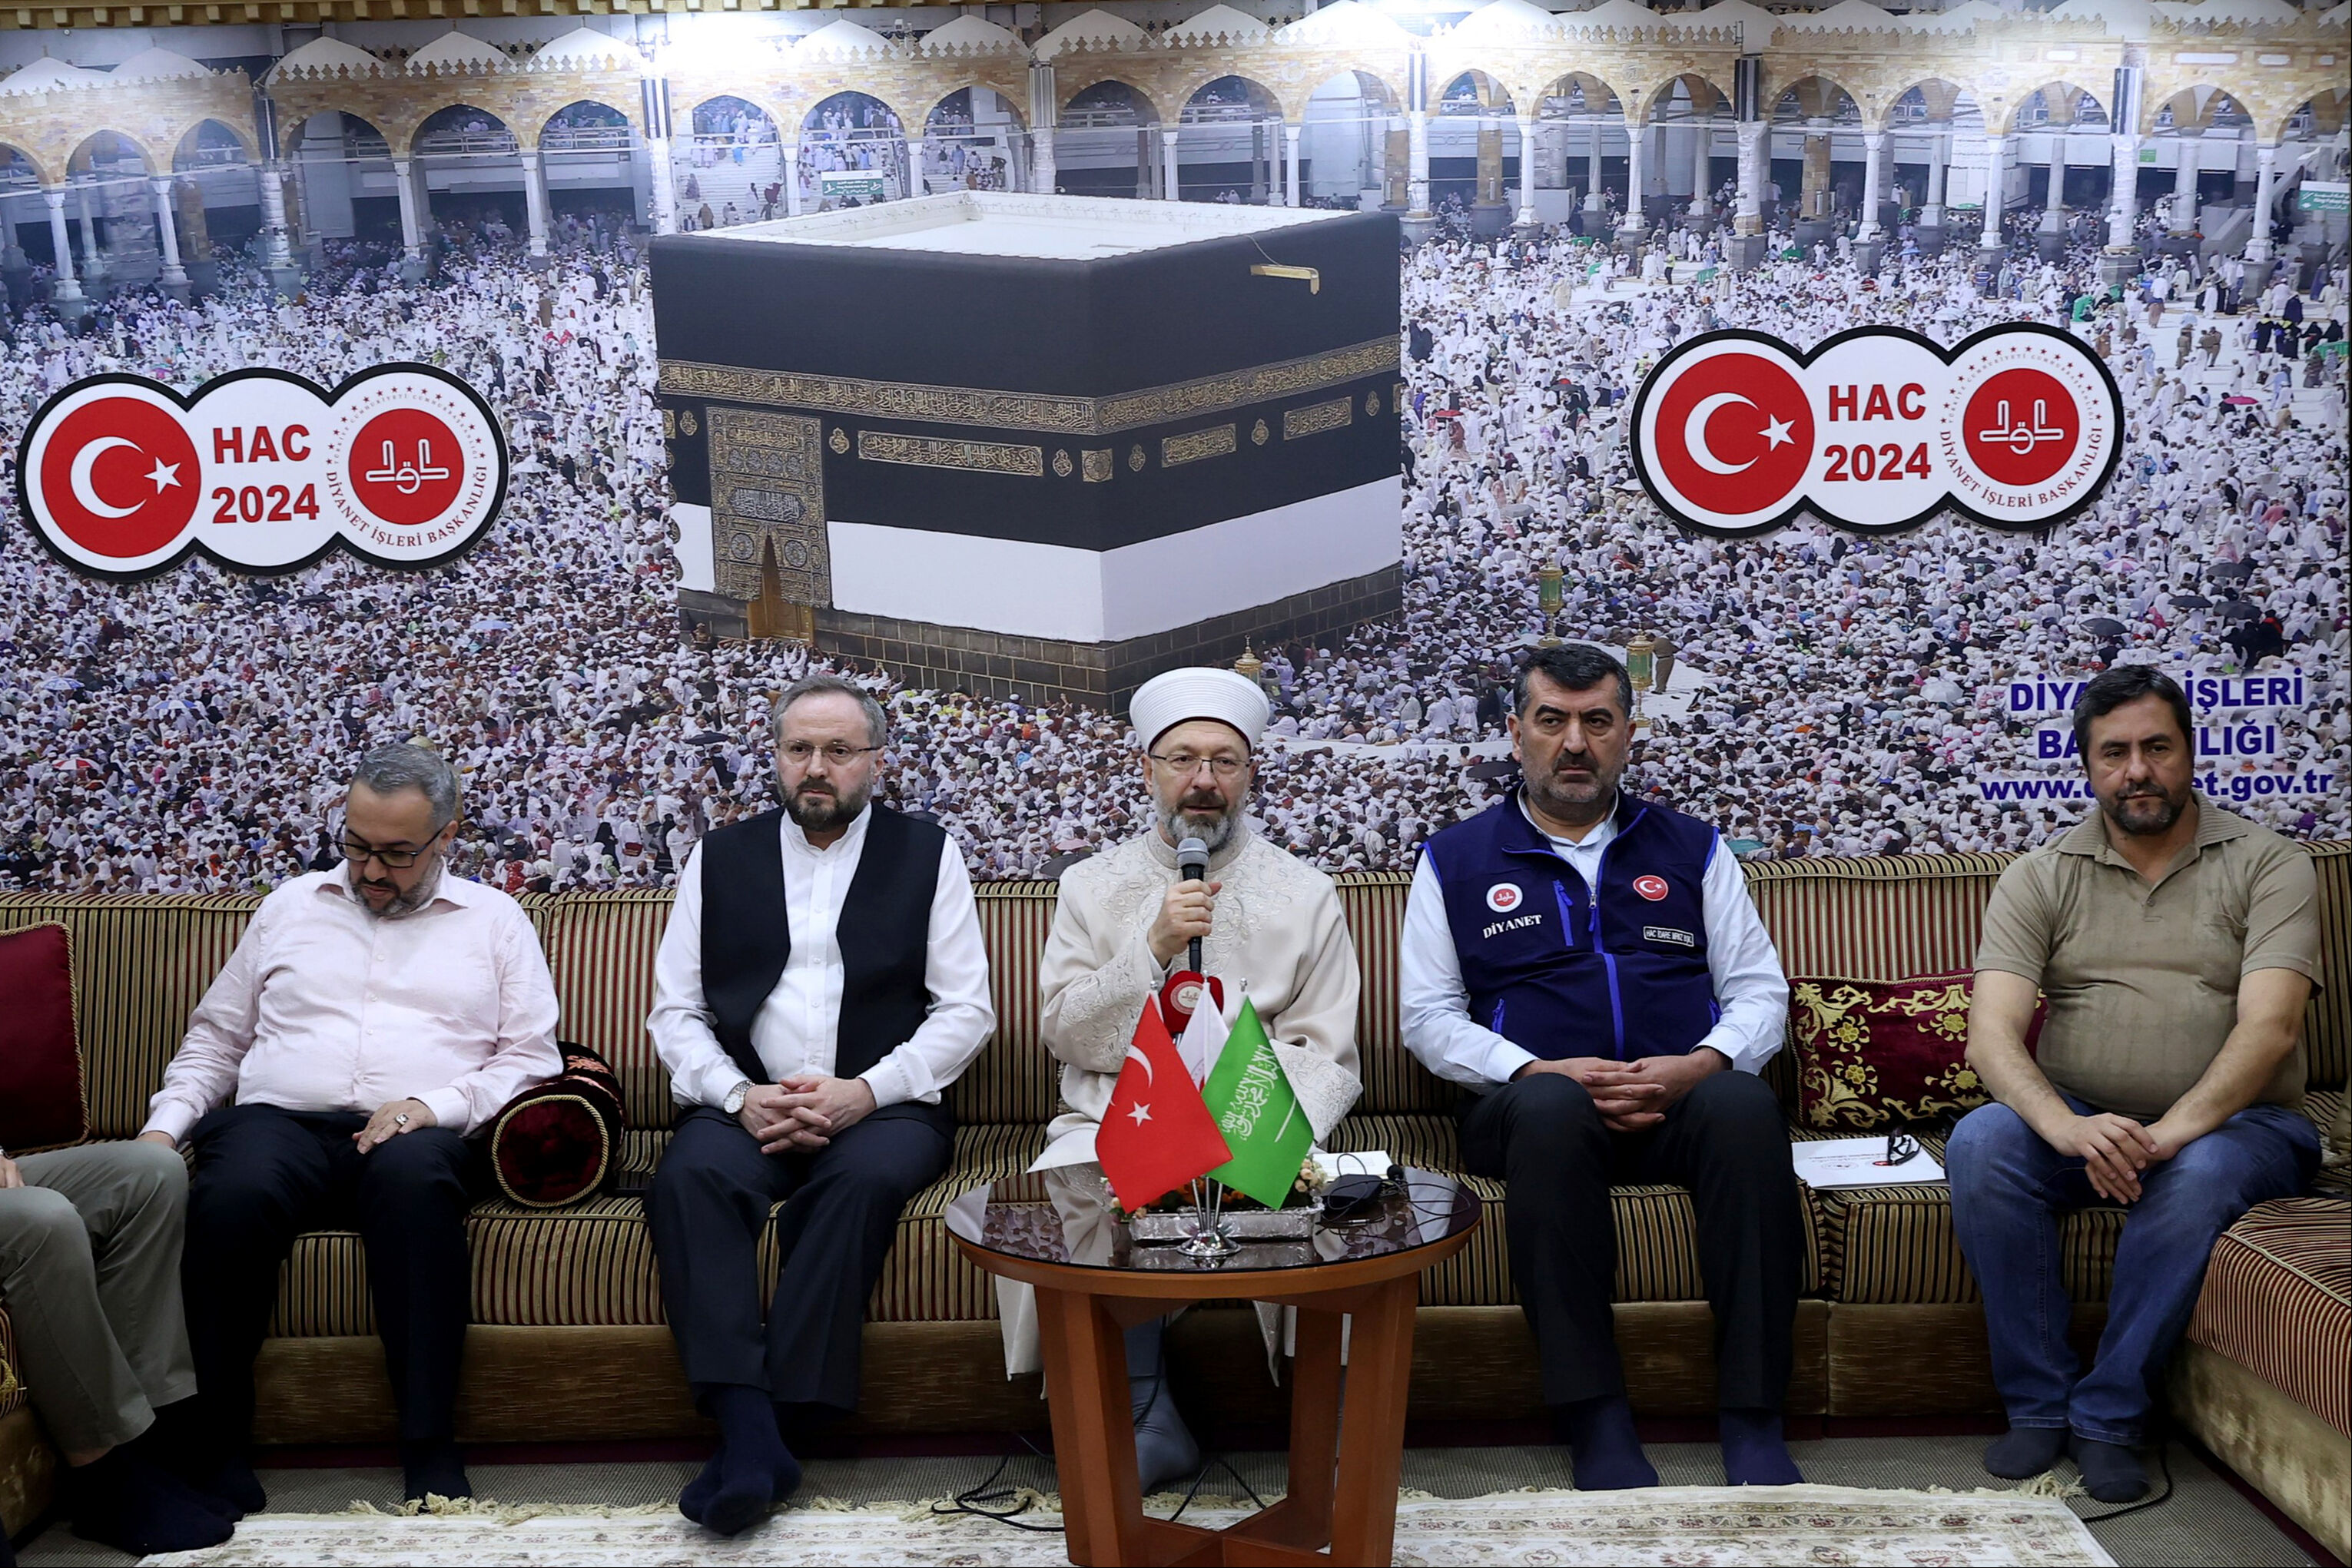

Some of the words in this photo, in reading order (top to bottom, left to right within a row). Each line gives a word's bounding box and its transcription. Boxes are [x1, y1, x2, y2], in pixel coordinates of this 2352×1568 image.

[1829, 383, 1926, 422] HAC
[213, 424, 311, 463] HAC
[1823, 442, 1932, 482] 2024
[1940, 431, 1981, 492] DİYANET
[1982, 486, 2033, 507] İŞLERİ
[2038, 427, 2102, 504] BAŞKANLIĞI
[211, 483, 320, 524] 2024
[327, 472, 369, 532] DİYANET
[370, 526, 423, 547] İŞLERİ
[427, 466, 487, 543] BAŞKANLIĞI
[2185, 667, 2302, 714] İŞLERİ
[2039, 719, 2274, 759] BALIĞI
[1483, 914, 1542, 939] DİYANET
